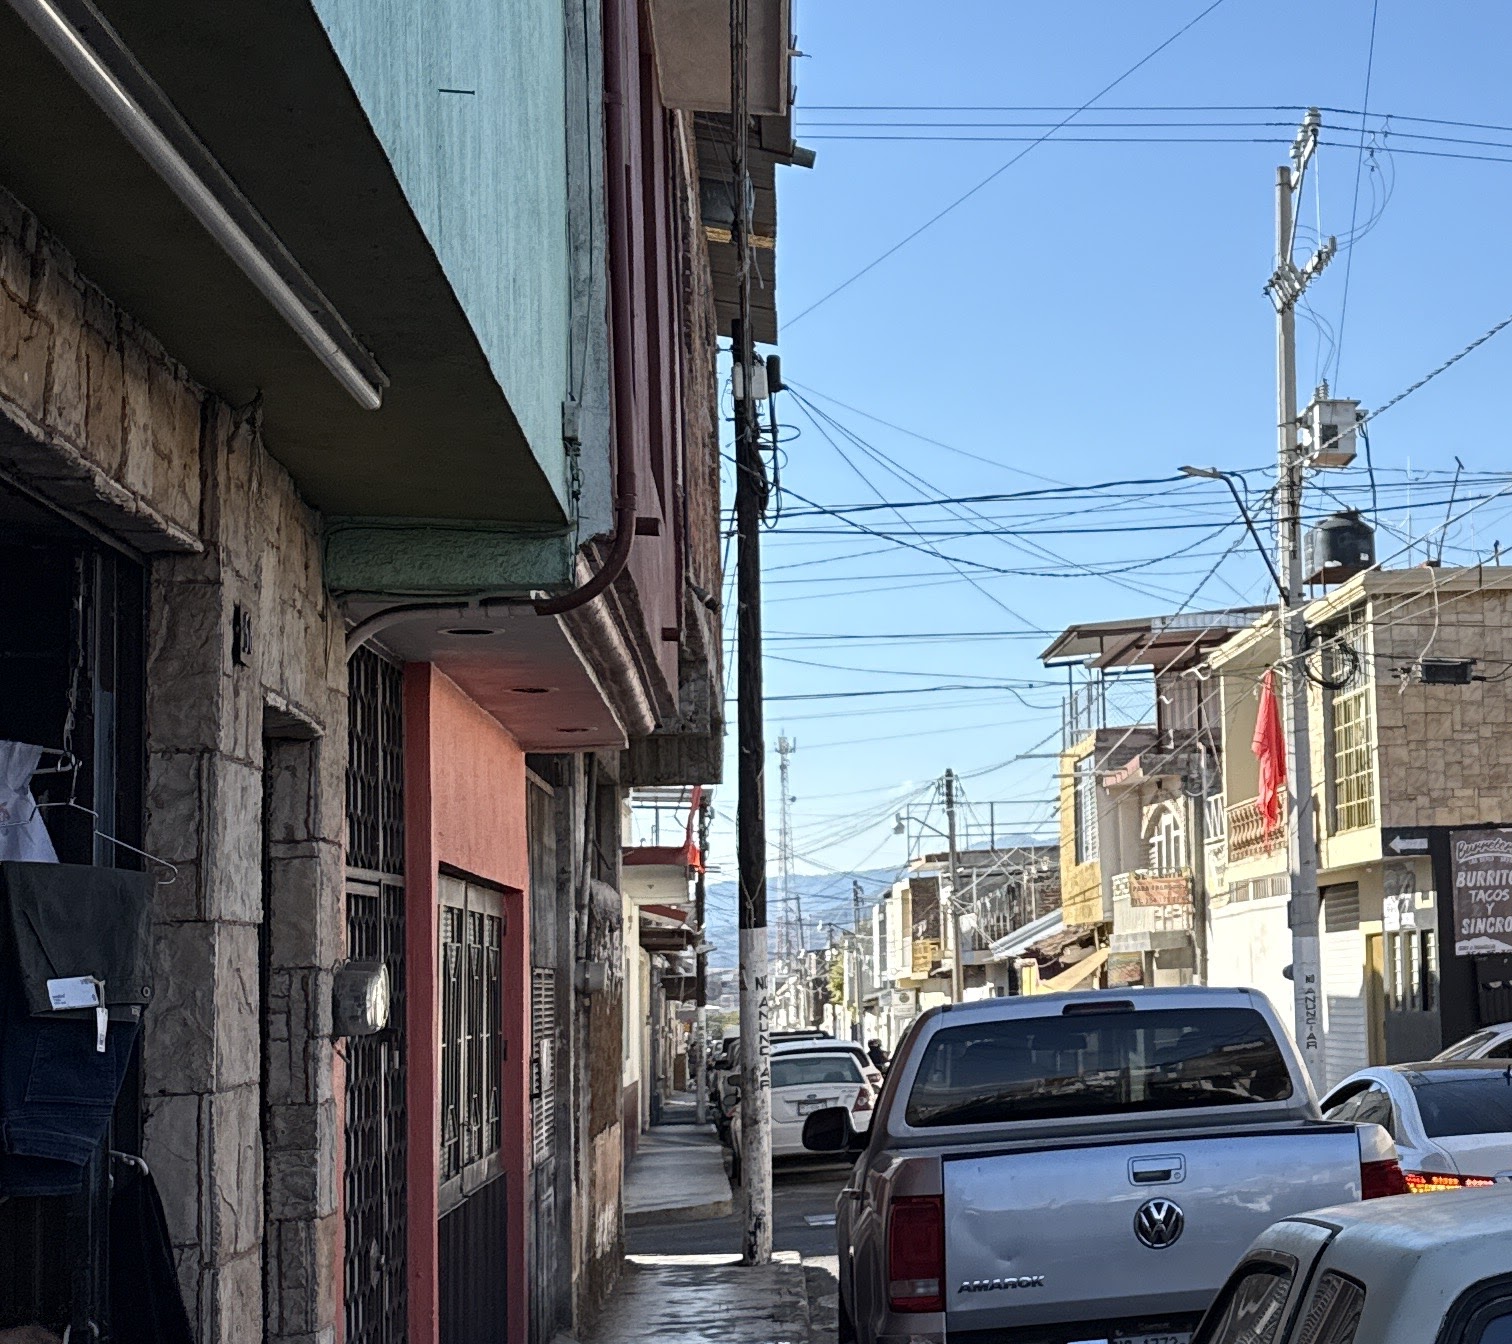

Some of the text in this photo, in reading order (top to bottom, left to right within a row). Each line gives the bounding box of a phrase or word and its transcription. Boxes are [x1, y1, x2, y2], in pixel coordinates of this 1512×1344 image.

[1468, 888, 1510, 903] TACOS
[1485, 902, 1496, 915] Y
[1305, 987, 1317, 1049] ANUNCIAR
[958, 1275, 1045, 1294] AMAROK
